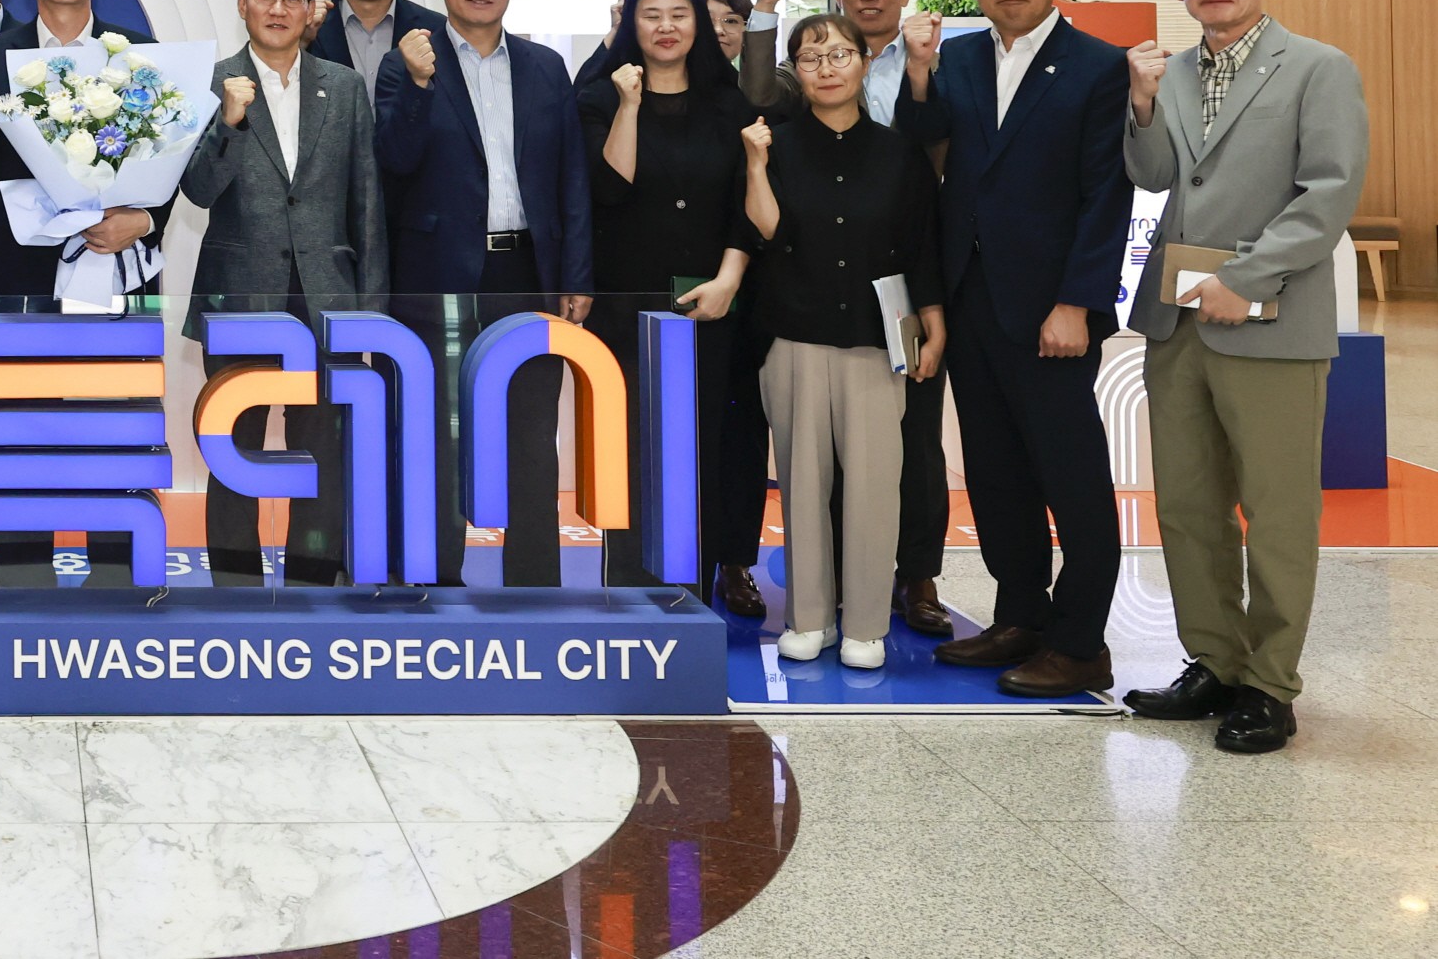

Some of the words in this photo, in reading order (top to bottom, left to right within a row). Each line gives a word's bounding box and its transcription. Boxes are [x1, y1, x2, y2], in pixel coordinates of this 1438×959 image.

[12, 638, 312, 680] HWASEONG
[328, 638, 542, 680] SPECIAL
[557, 638, 677, 680] CITY
